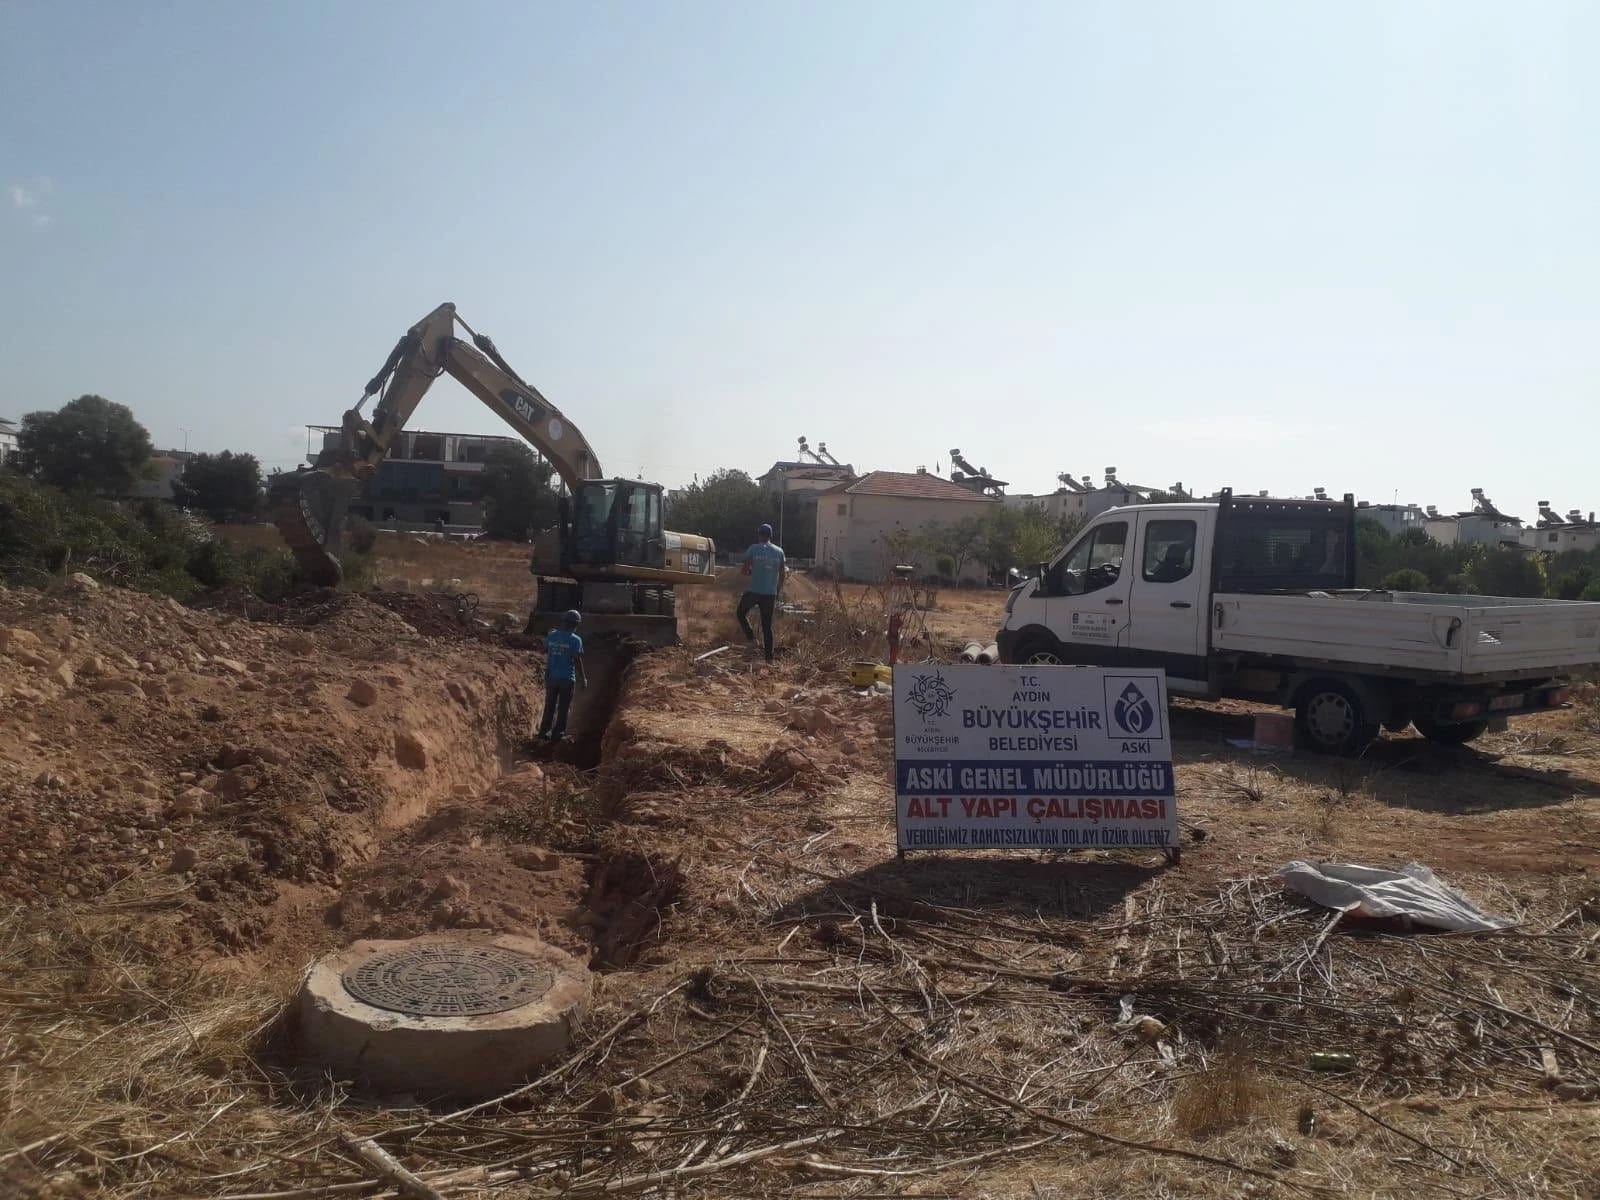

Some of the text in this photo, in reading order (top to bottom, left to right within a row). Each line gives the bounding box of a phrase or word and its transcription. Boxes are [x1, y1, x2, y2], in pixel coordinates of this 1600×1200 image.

[515, 396, 534, 421] CAT
[1020, 676, 1040, 687] T.C.
[1012, 691, 1050, 702] AYDIN
[962, 705, 1102, 734] BÜYÜKŞEHİR
[905, 735, 960, 745] BÜYÜKŞEHİR
[989, 735, 1078, 751] BELEDİYESİ
[1121, 740, 1151, 753] ASKİ
[906, 763, 1165, 790] ASKİ GENEL MÜDÜRLÜĞÜ
[906, 798, 1166, 824] ALT YAPI ÇALIŞMASI
[906, 827, 1171, 846] VERDİĞİMİZ RAHATSIZLIKTAN DOLAYI ÖZÜR DİLERİZ
